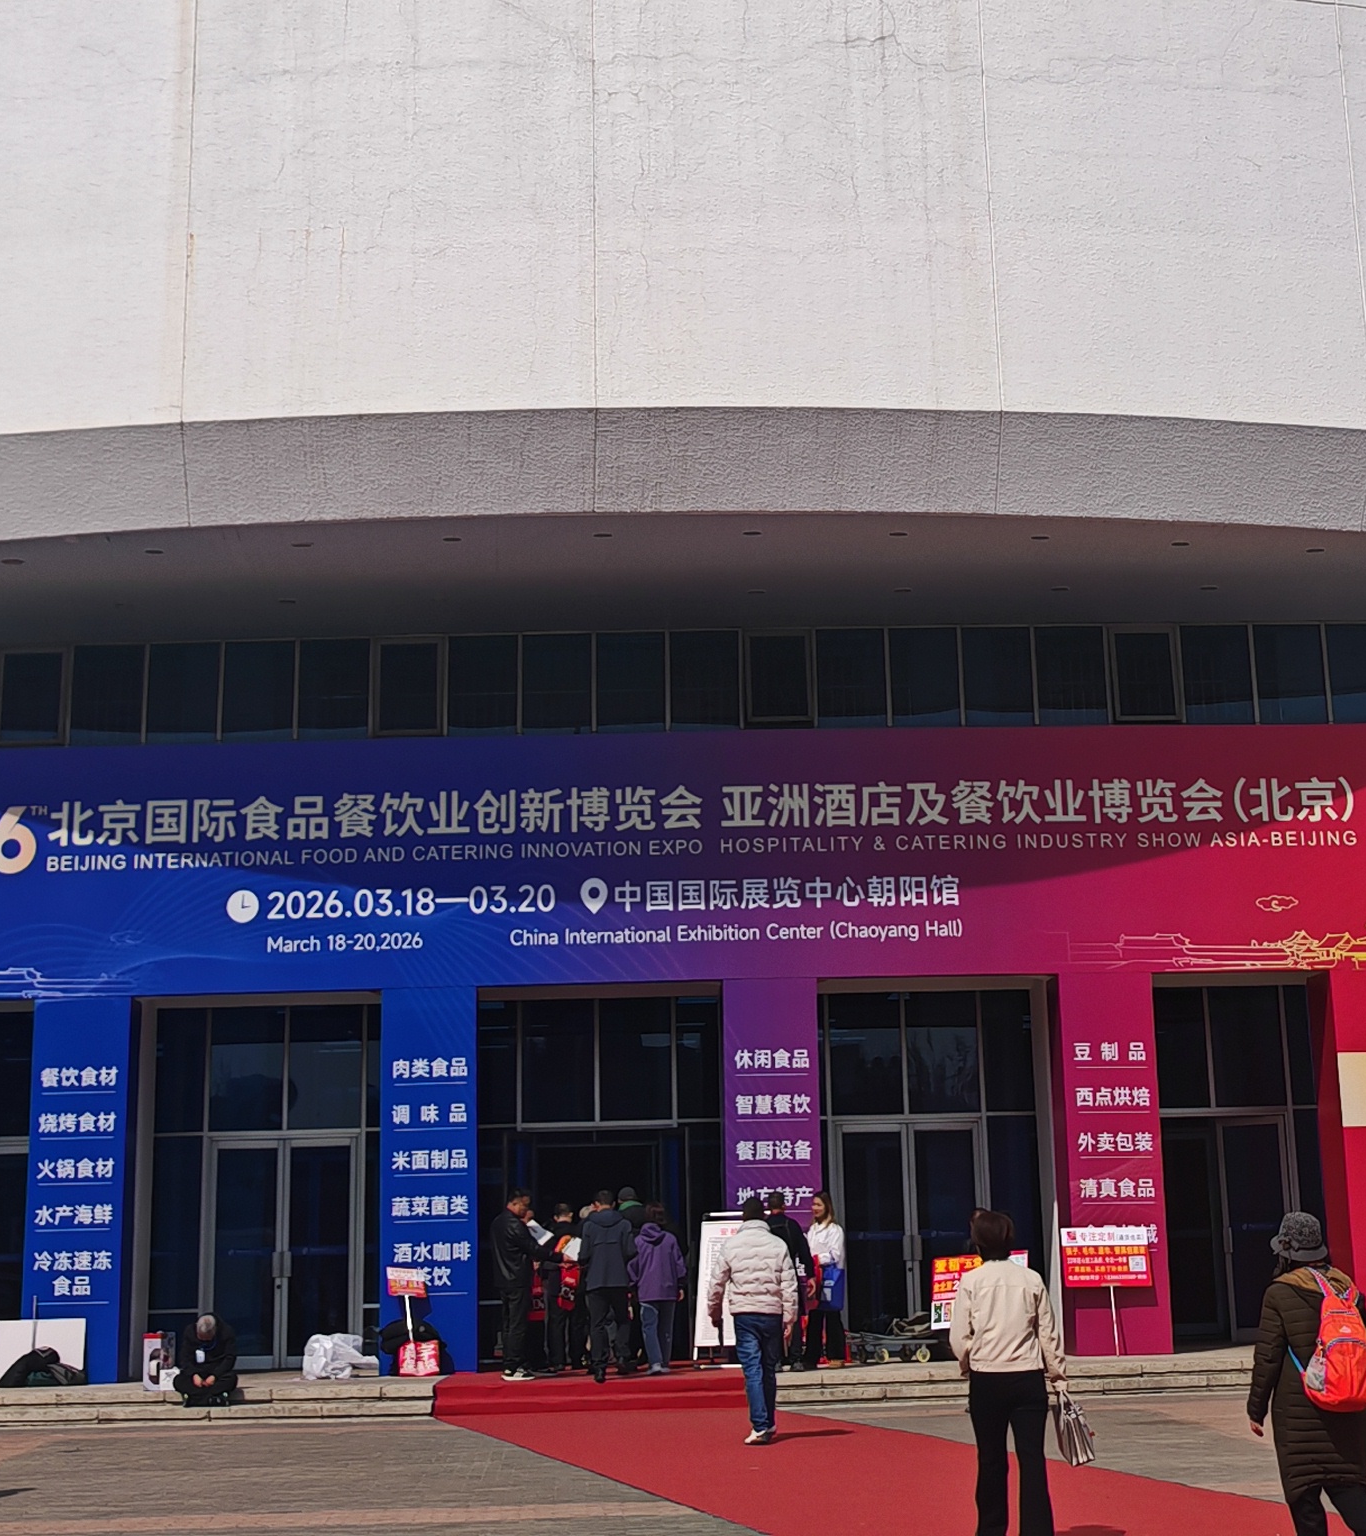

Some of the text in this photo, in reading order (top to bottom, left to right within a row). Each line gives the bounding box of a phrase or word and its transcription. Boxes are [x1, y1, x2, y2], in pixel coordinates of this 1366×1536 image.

[47, 785, 703, 847] 北京国际食品餐饮业创新博览会
[720, 830, 1358, 854] HOSPITALITY & CATERING INDUSTRY SHOW ASIA-BEIJING
[46, 839, 703, 872] BEIJING INTERNATIONAL FOOD AND CATERING INNOVATION EXPO
[613, 875, 960, 912] 中国国际展览中心朝阳馆
[267, 932, 423, 953] March 18-20,2026
[509, 918, 963, 946] China International Exhibition Center (Chaoyang Hall)
[734, 1048, 811, 1070] 休闲食品
[1073, 1041, 1147, 1063] 豆制品
[40, 1067, 119, 1088] 餐饮食材
[392, 1057, 469, 1079] 肉类食品
[735, 1094, 812, 1116] 智慧餐饮
[1075, 1086, 1151, 1108] 西点烘焙
[38, 1112, 117, 1133] 烧烤食材
[392, 1103, 468, 1125] 调味品
[736, 1139, 813, 1162] 餐厨设备
[1077, 1131, 1154, 1154] 外卖包装
[37, 1158, 115, 1180] 火锅食材
[392, 1149, 469, 1171] 米面制品
[1079, 1176, 1156, 1200] 清真食品
[35, 1204, 113, 1226] 水产海鲜
[391, 1195, 469, 1217] 蔬菜菌类
[33, 1250, 112, 1272] 冷冻速冻
[393, 1241, 471, 1263] 酒水咖啡
[51, 1276, 91, 1297] 食品
